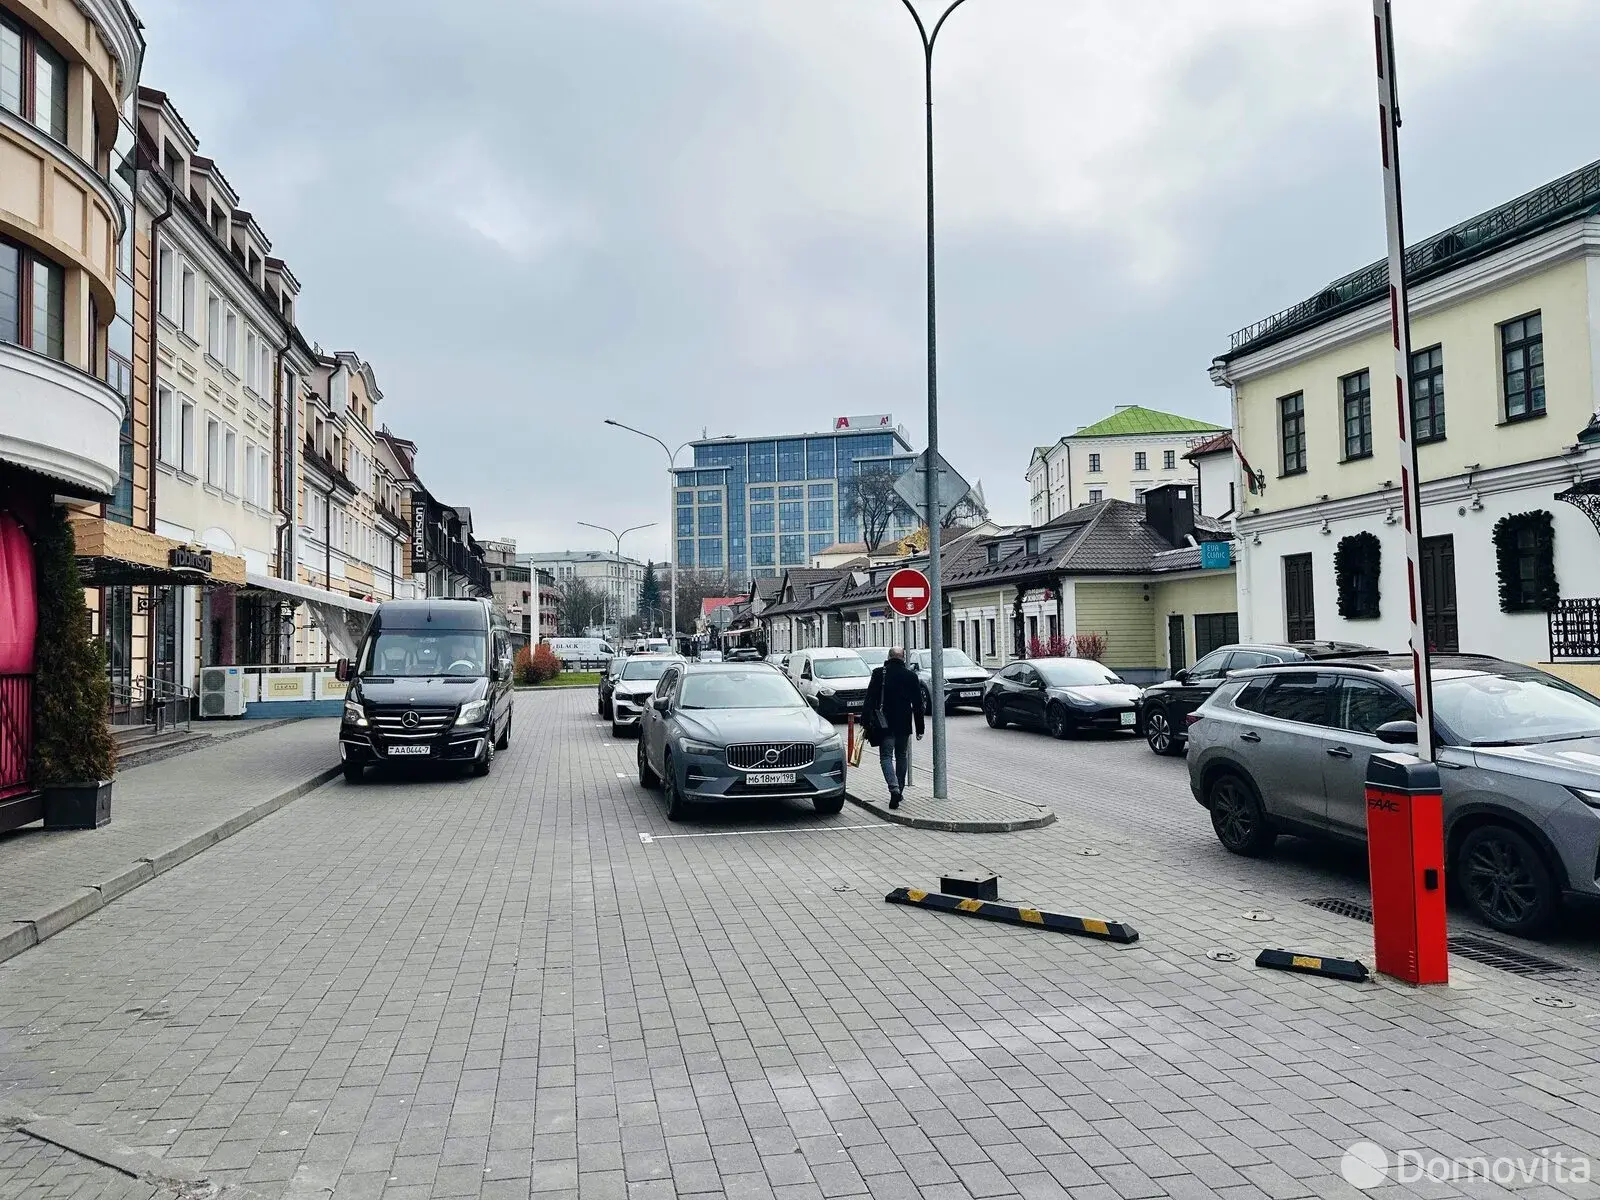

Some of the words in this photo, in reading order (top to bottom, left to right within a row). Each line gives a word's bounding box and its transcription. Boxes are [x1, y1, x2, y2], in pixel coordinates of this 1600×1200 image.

[412, 507, 424, 558] robinson
[1206, 551, 1226, 559] CLINIC
[1367, 797, 1401, 813] FAAC
